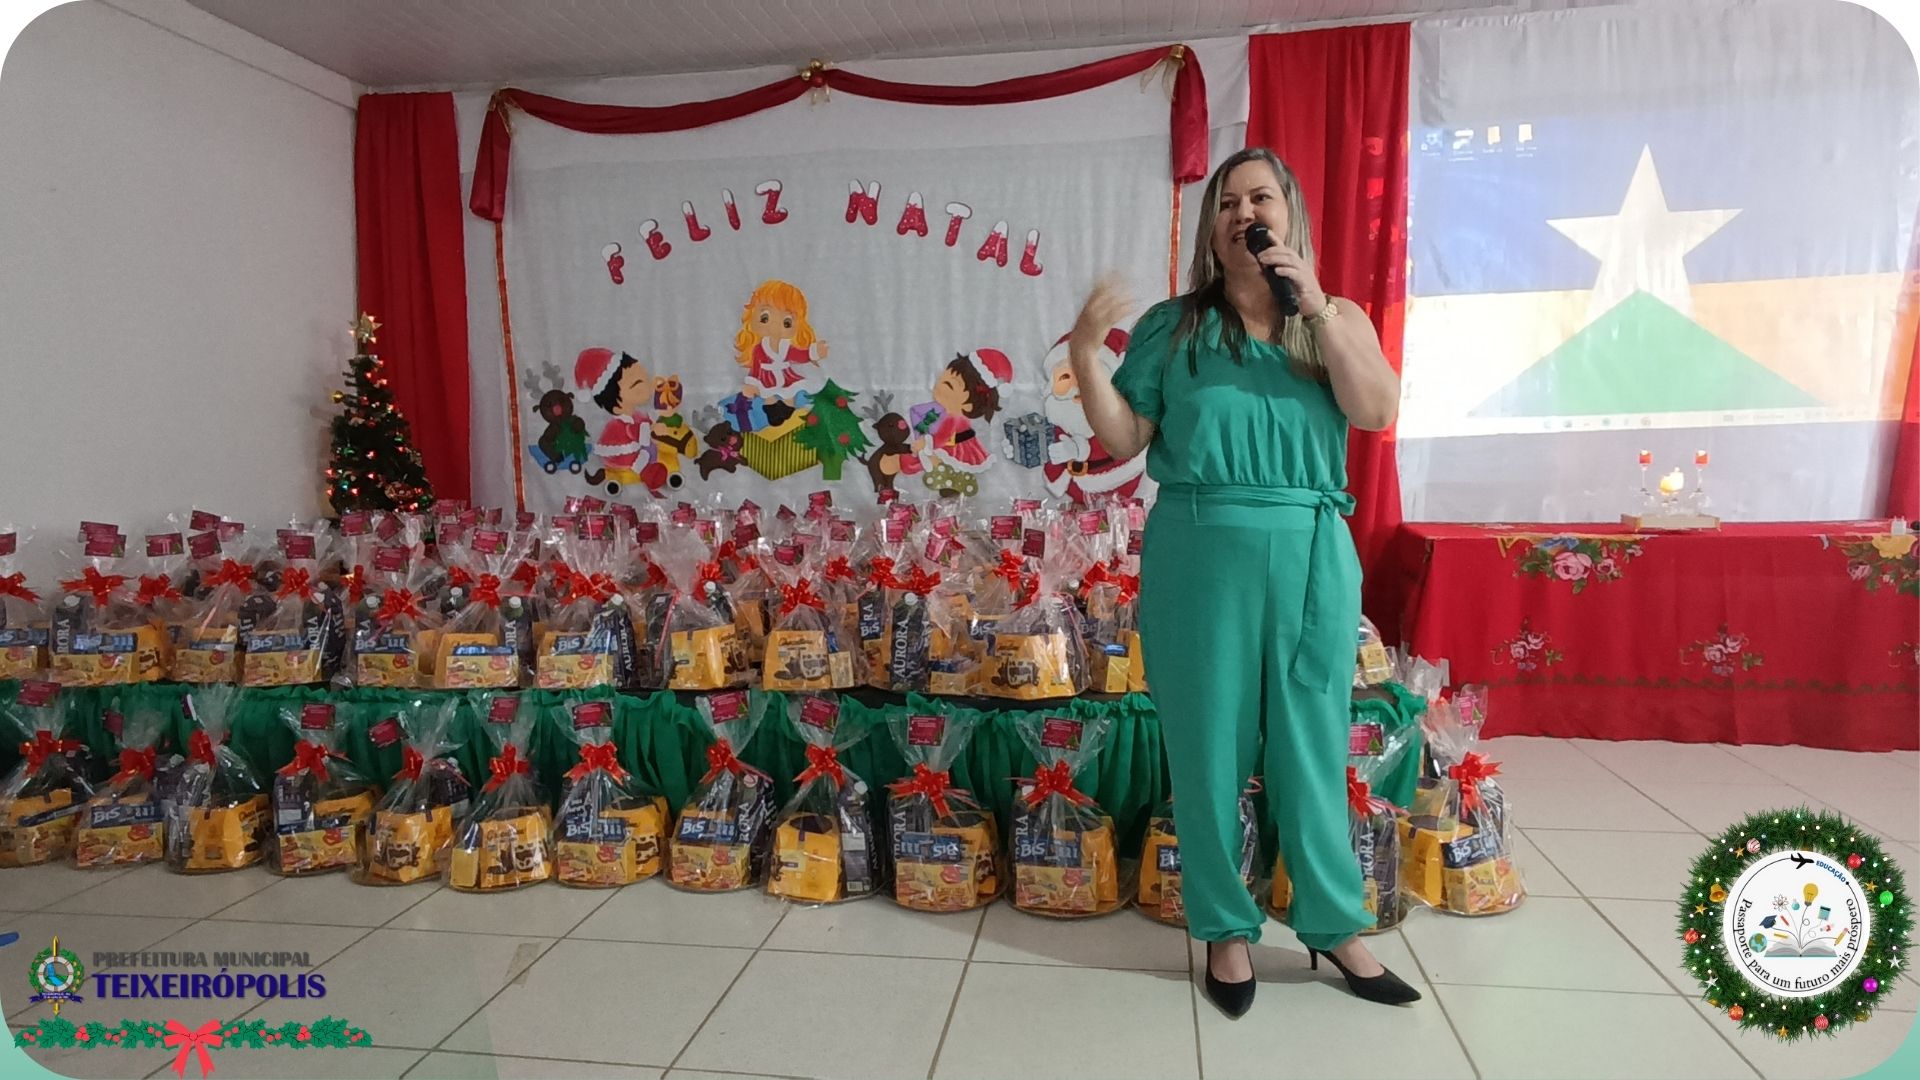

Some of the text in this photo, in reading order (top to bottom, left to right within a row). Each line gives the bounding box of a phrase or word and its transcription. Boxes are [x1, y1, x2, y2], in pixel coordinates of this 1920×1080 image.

[601, 178, 1044, 285] FELIZ NATAL
[619, 618, 633, 672] AURORA
[894, 618, 910, 679] AURORA
